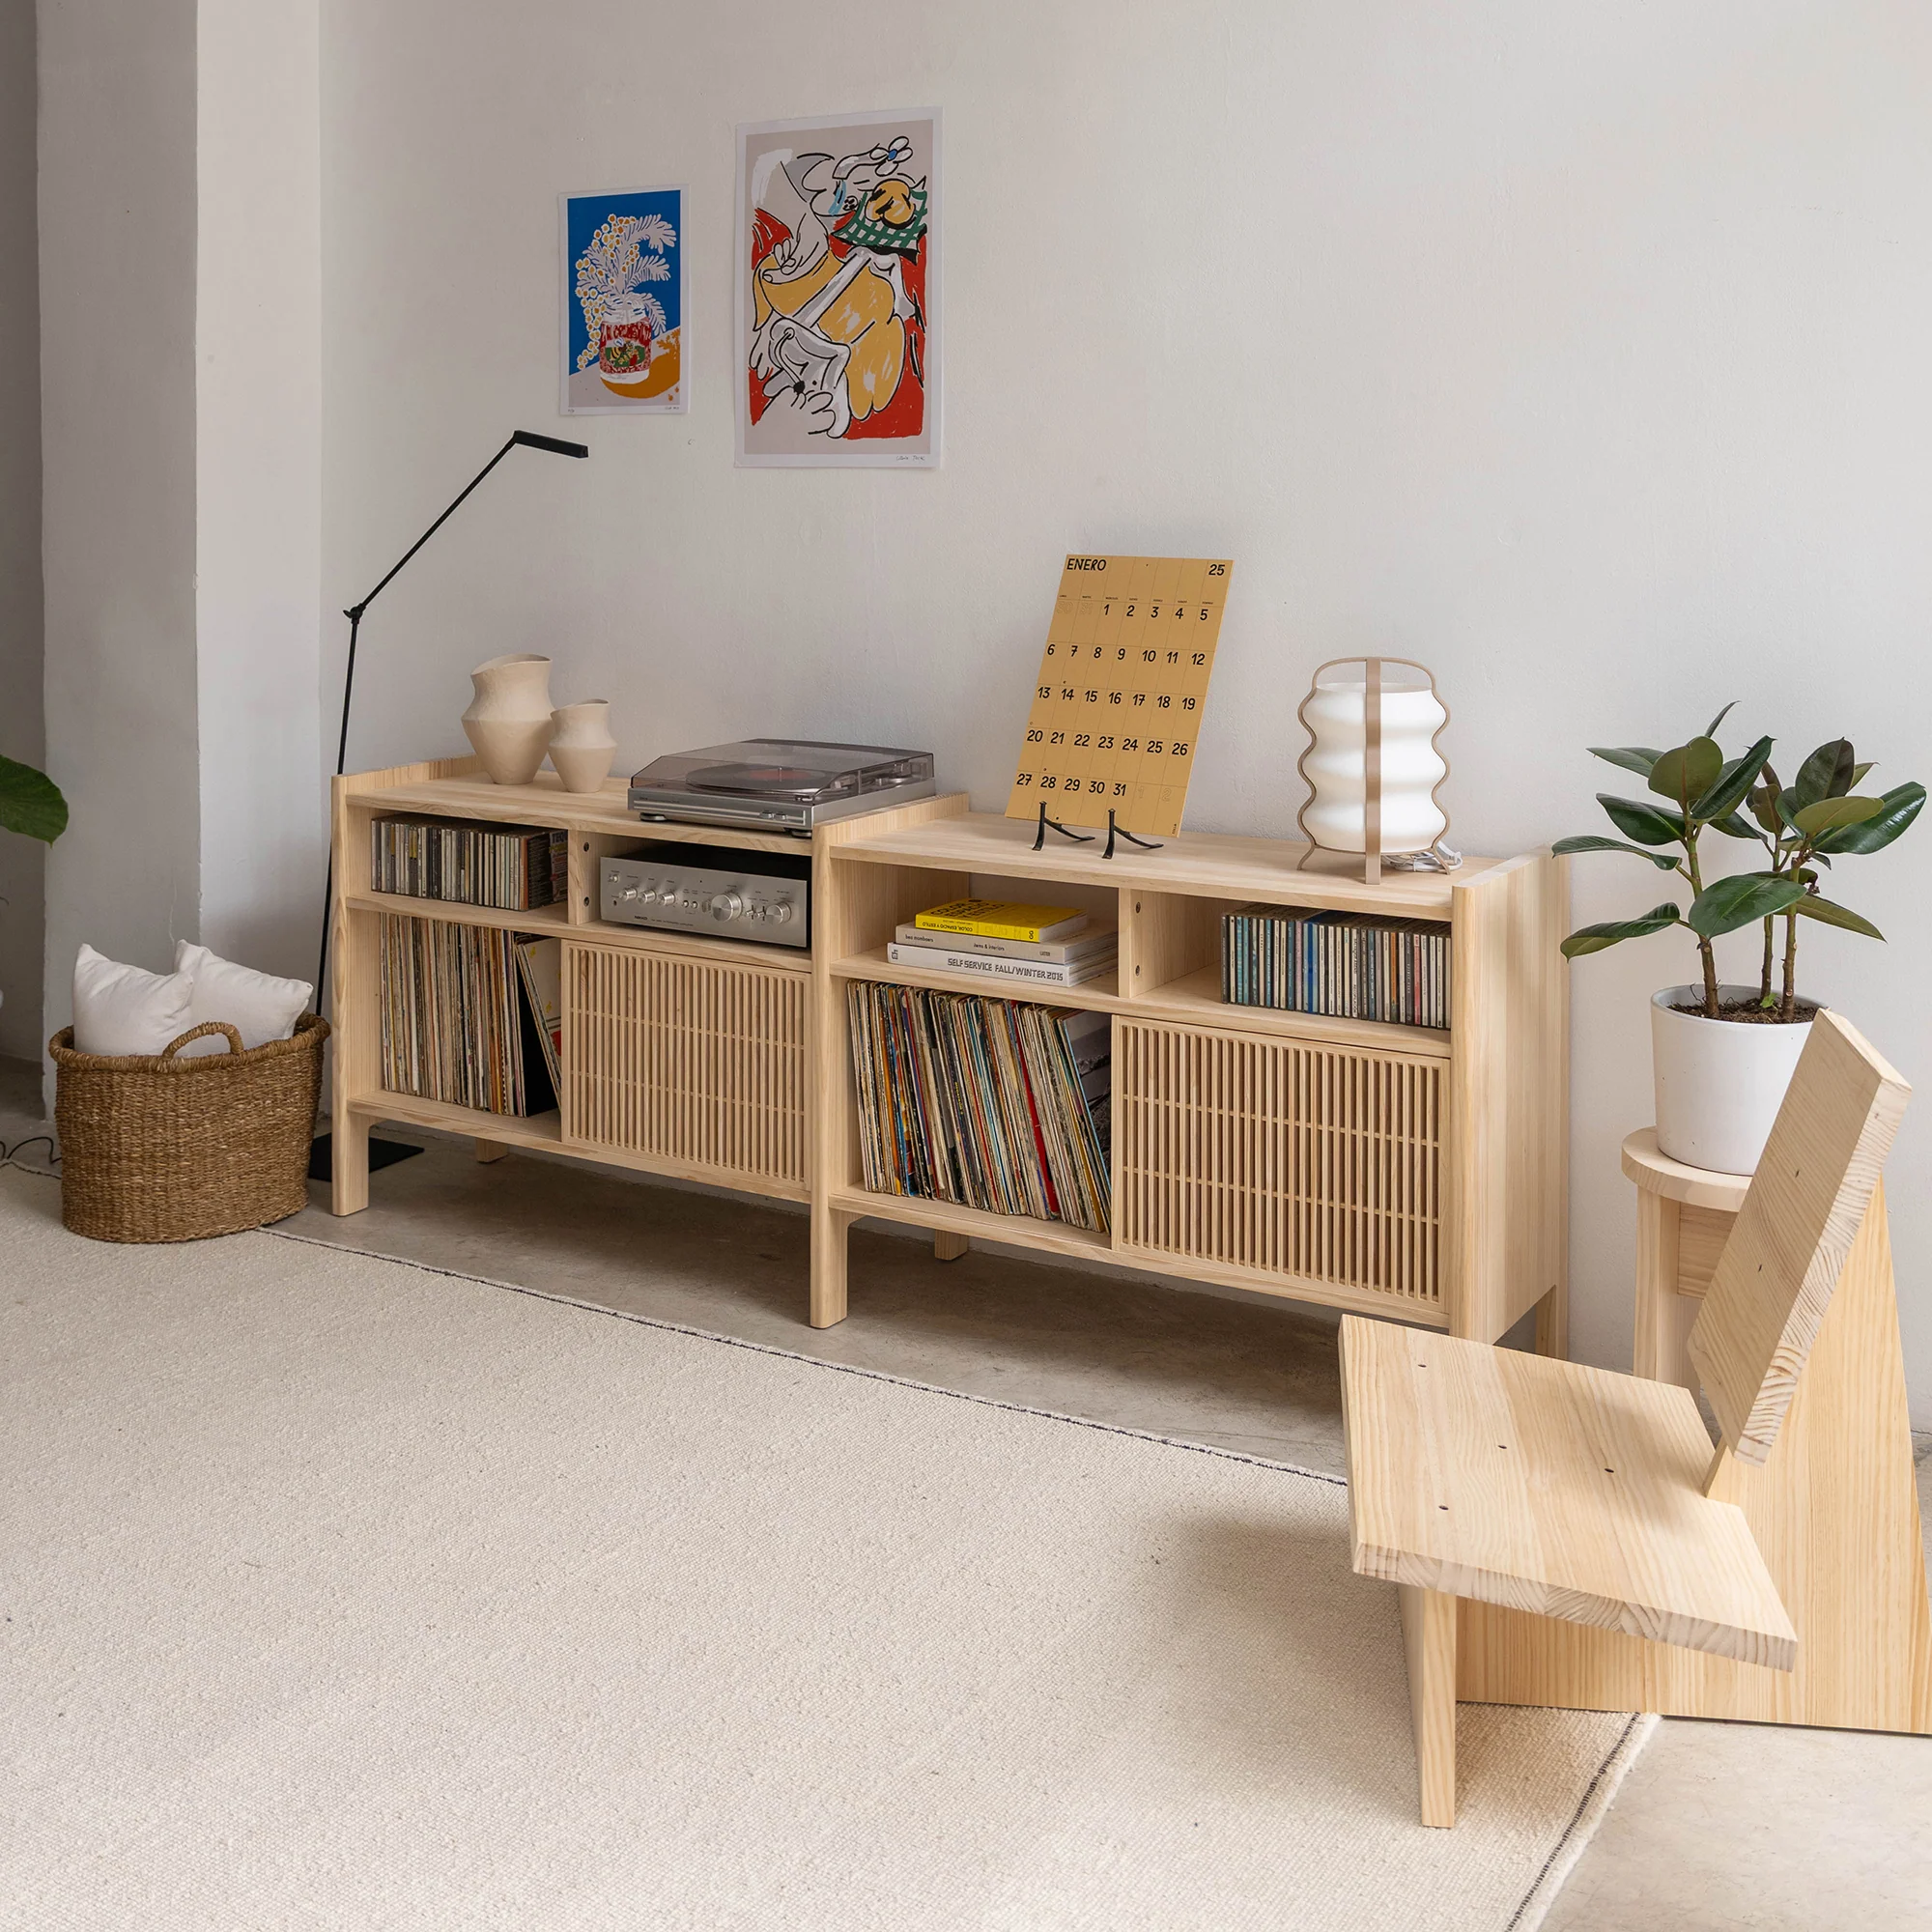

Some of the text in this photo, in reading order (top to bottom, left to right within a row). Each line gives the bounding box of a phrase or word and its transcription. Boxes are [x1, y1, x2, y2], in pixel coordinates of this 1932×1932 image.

[1066, 558, 1225, 576] ENERO 25
[1103, 603, 1110, 616] 1
[1125, 604, 1135, 617] 2
[1151, 606, 1160, 618] 3
[1175, 607, 1184, 620] 4
[1199, 608, 1209, 621] 5
[1046, 643, 1206, 666] 6 7 8 9 10 11 12
[1037, 686, 1196, 711] 13 14 15 16 17 18 19
[1026, 728, 1189, 756] 20 21 22 23 24 25 26
[1015, 773, 1033, 786] 27
[1039, 775, 1057, 789] 28
[1064, 778, 1081, 792] 29
[1088, 780, 1106, 795] 30
[1112, 782, 1127, 797] 31
[948, 957, 1064, 981] SELF SERVICE FALL/WINTER 2015
